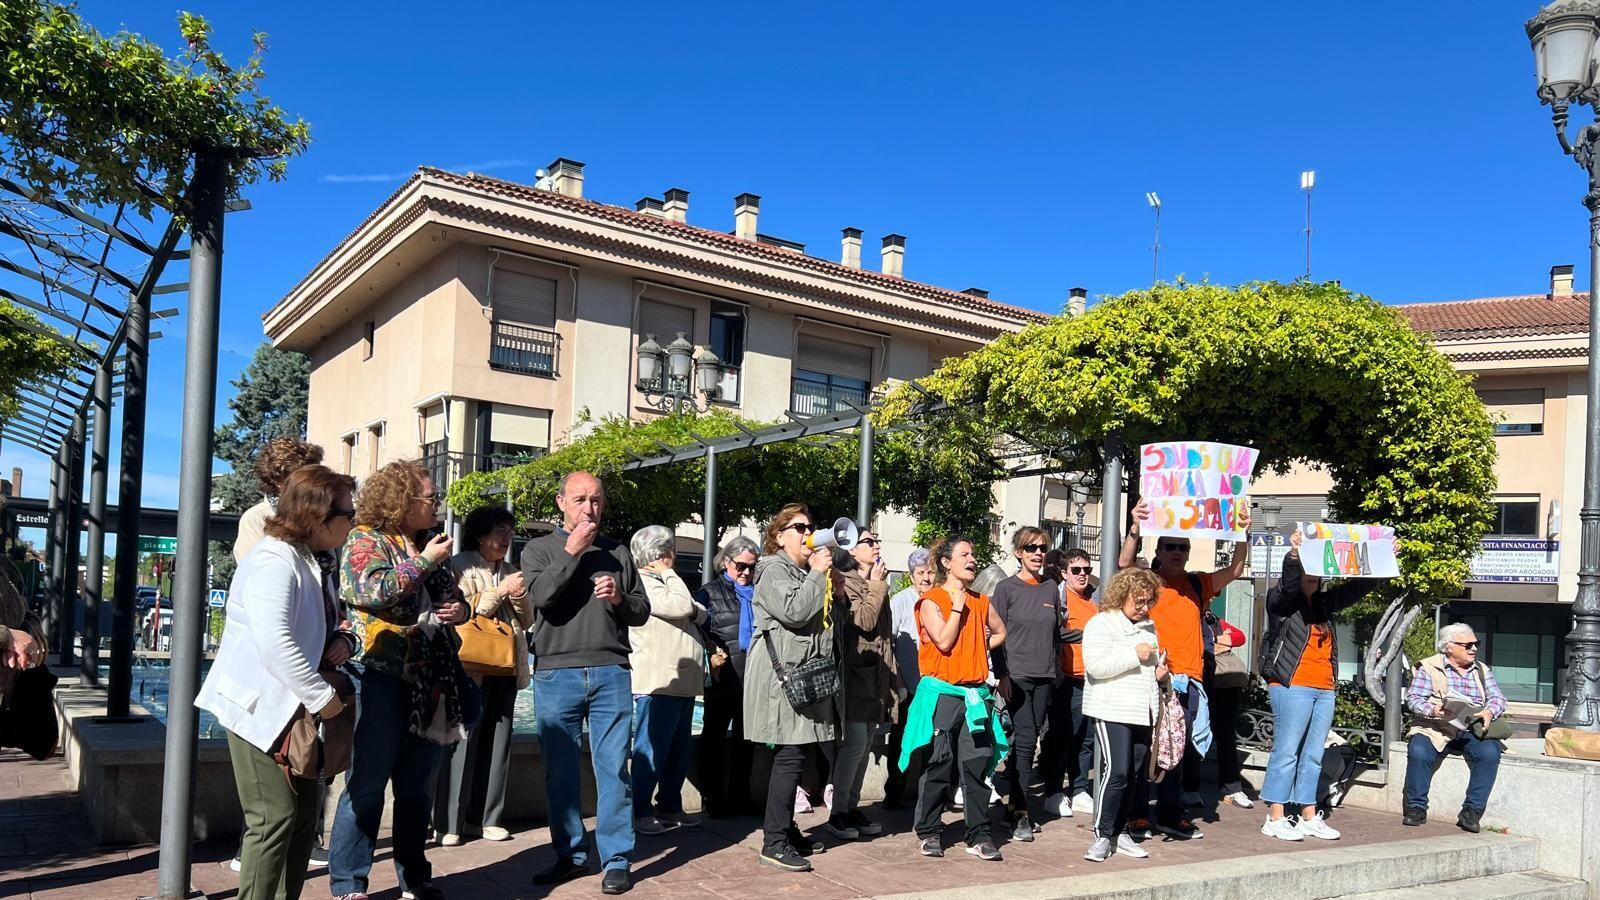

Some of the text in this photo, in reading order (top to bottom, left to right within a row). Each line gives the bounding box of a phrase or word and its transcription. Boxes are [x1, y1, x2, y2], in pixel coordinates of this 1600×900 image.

[1144, 443, 1251, 476] SOMOS UNA
[1219, 473, 1242, 495] NO
[170, 542, 177, 550] M
[1323, 540, 1372, 576] ATAM
